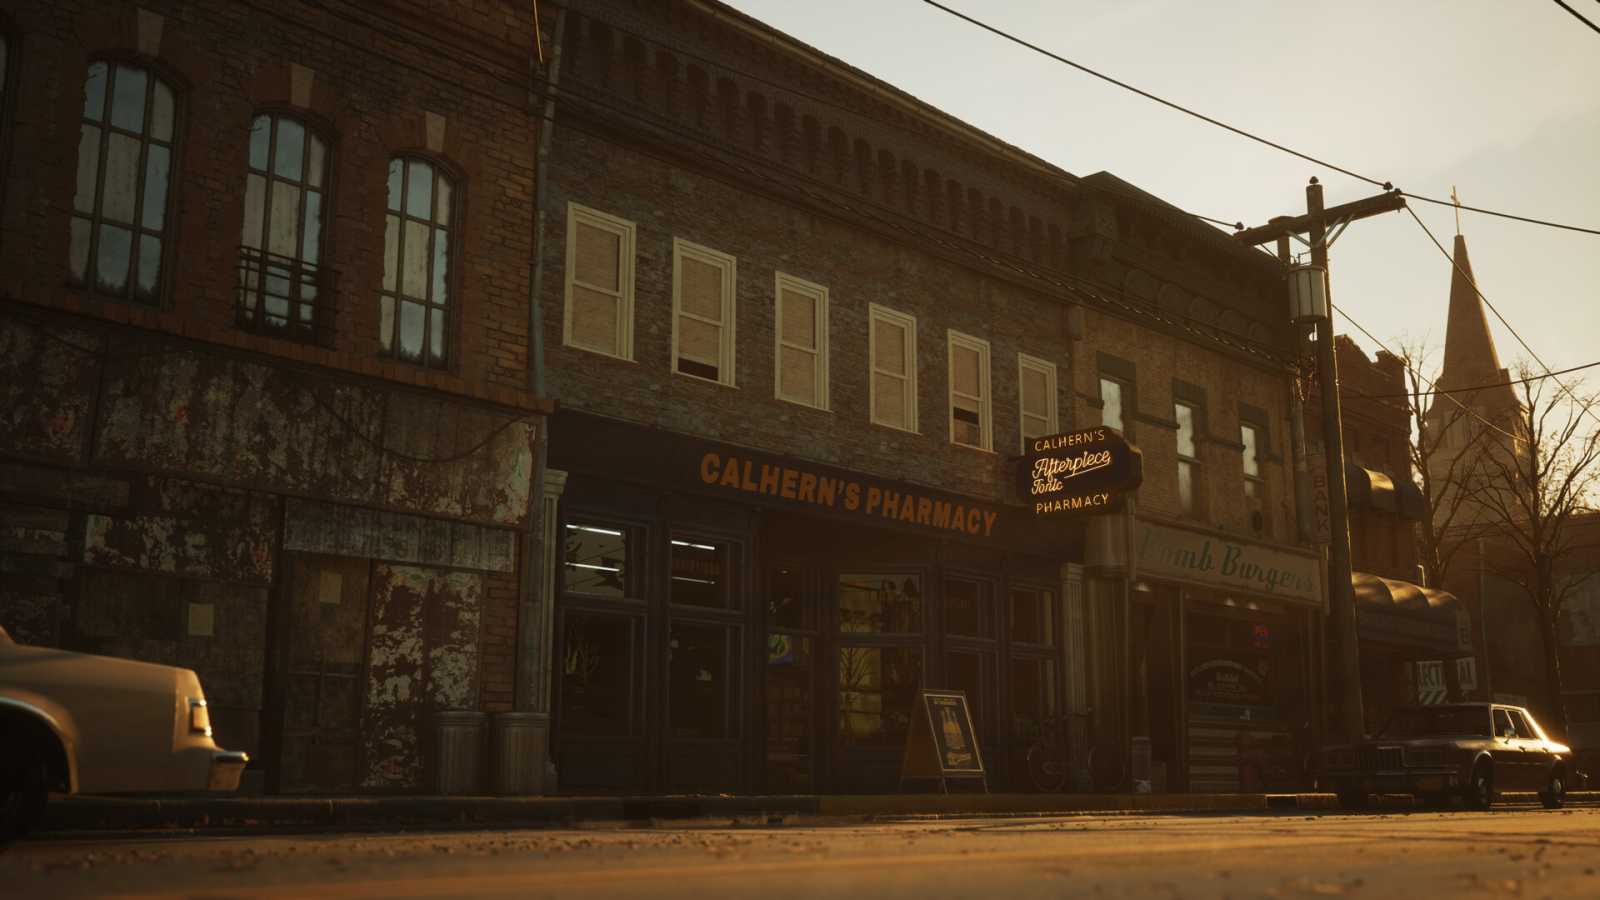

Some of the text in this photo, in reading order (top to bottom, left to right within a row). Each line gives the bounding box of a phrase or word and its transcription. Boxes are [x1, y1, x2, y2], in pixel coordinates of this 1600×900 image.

[1034, 429, 1106, 452] CALHERN'S
[1031, 449, 1111, 483] Afterpiece
[701, 452, 998, 536] CALHERN'S PHARMACY
[1031, 477, 1065, 495] Tonic
[1036, 493, 1110, 514] PHARMACY
